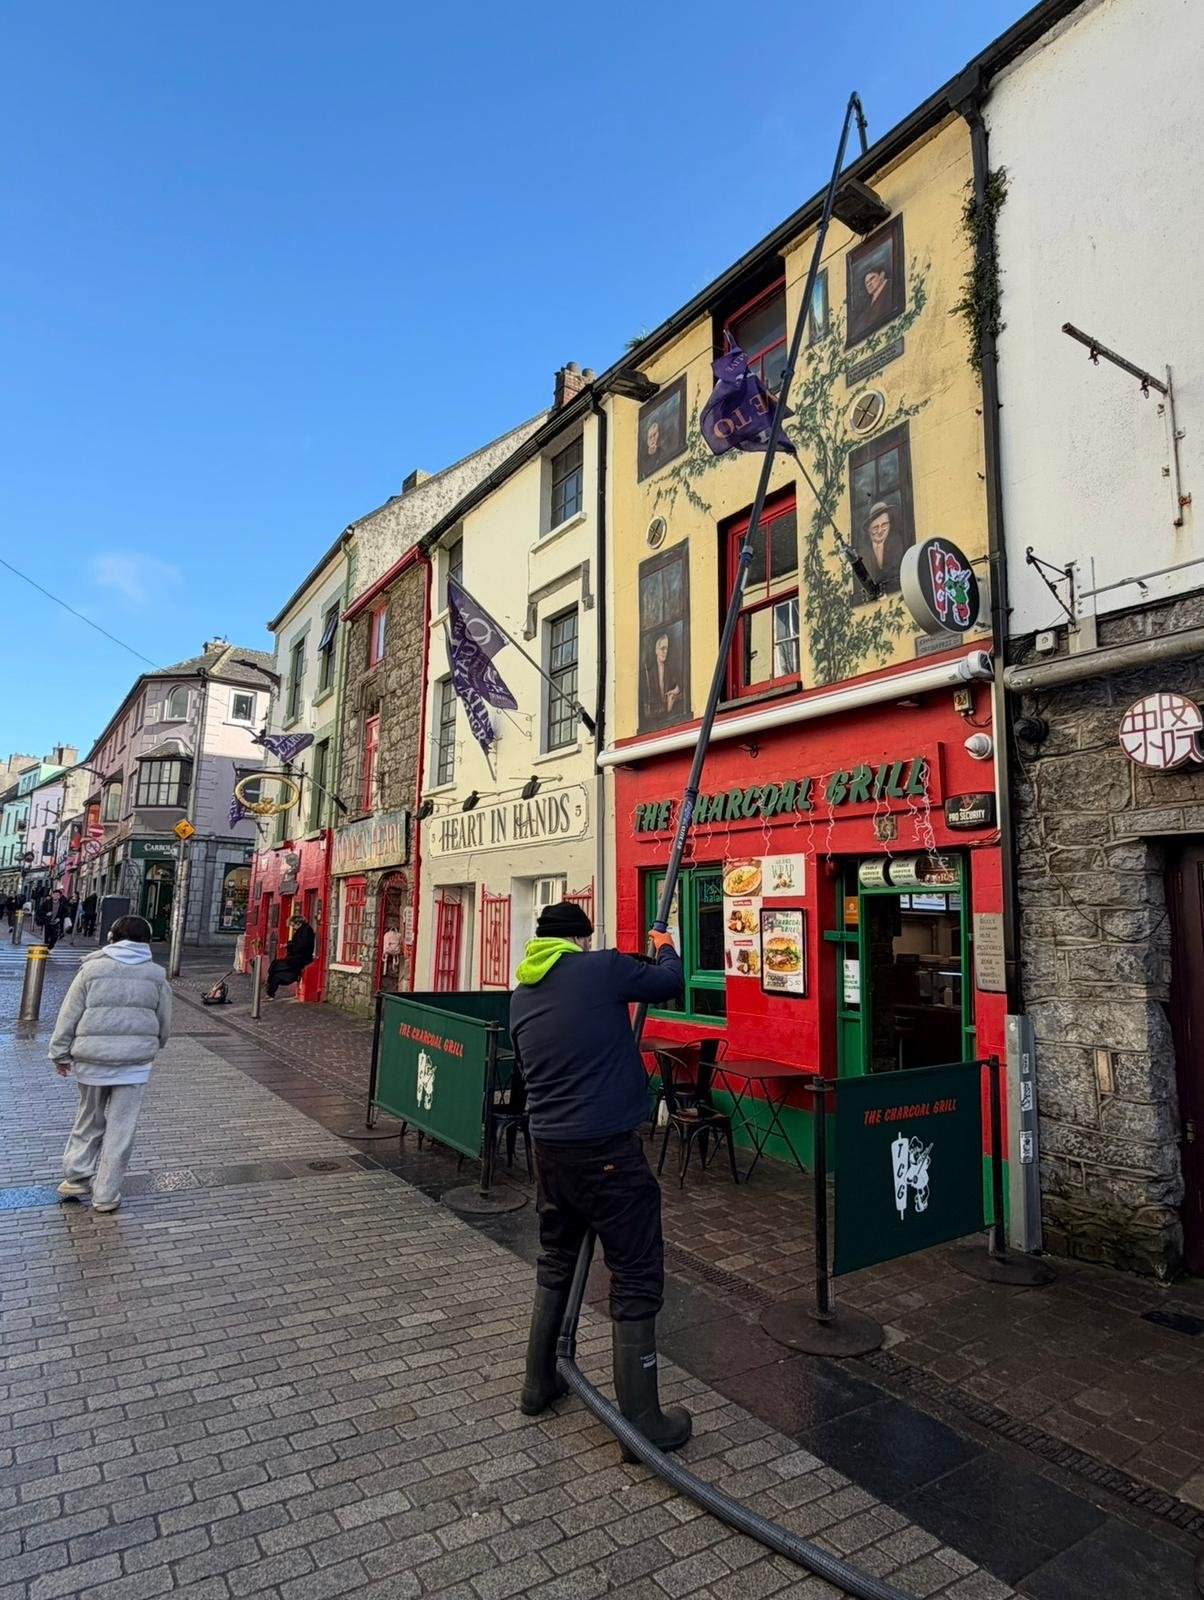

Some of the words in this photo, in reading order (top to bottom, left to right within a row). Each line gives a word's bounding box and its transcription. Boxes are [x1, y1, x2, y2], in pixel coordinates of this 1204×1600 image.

[635, 799, 673, 833] THE
[691, 776, 813, 824] HARCOAL
[826, 756, 927, 806] GRILL
[948, 812, 960, 823] PRO
[959, 809, 986, 821] SECURITY
[439, 811, 486, 852] HEART
[490, 806, 507, 844] IN
[513, 792, 570, 840] HANDS
[399, 1022, 411, 1038] THE
[411, 1027, 442, 1050] CHARCOAL
[443, 1038, 464, 1058] GRILL
[864, 1109, 882, 1125] THE
[884, 1103, 931, 1122] CHARCOAL
[933, 1098, 957, 1115] GRILL
[896, 1143, 905, 1200] TCG
